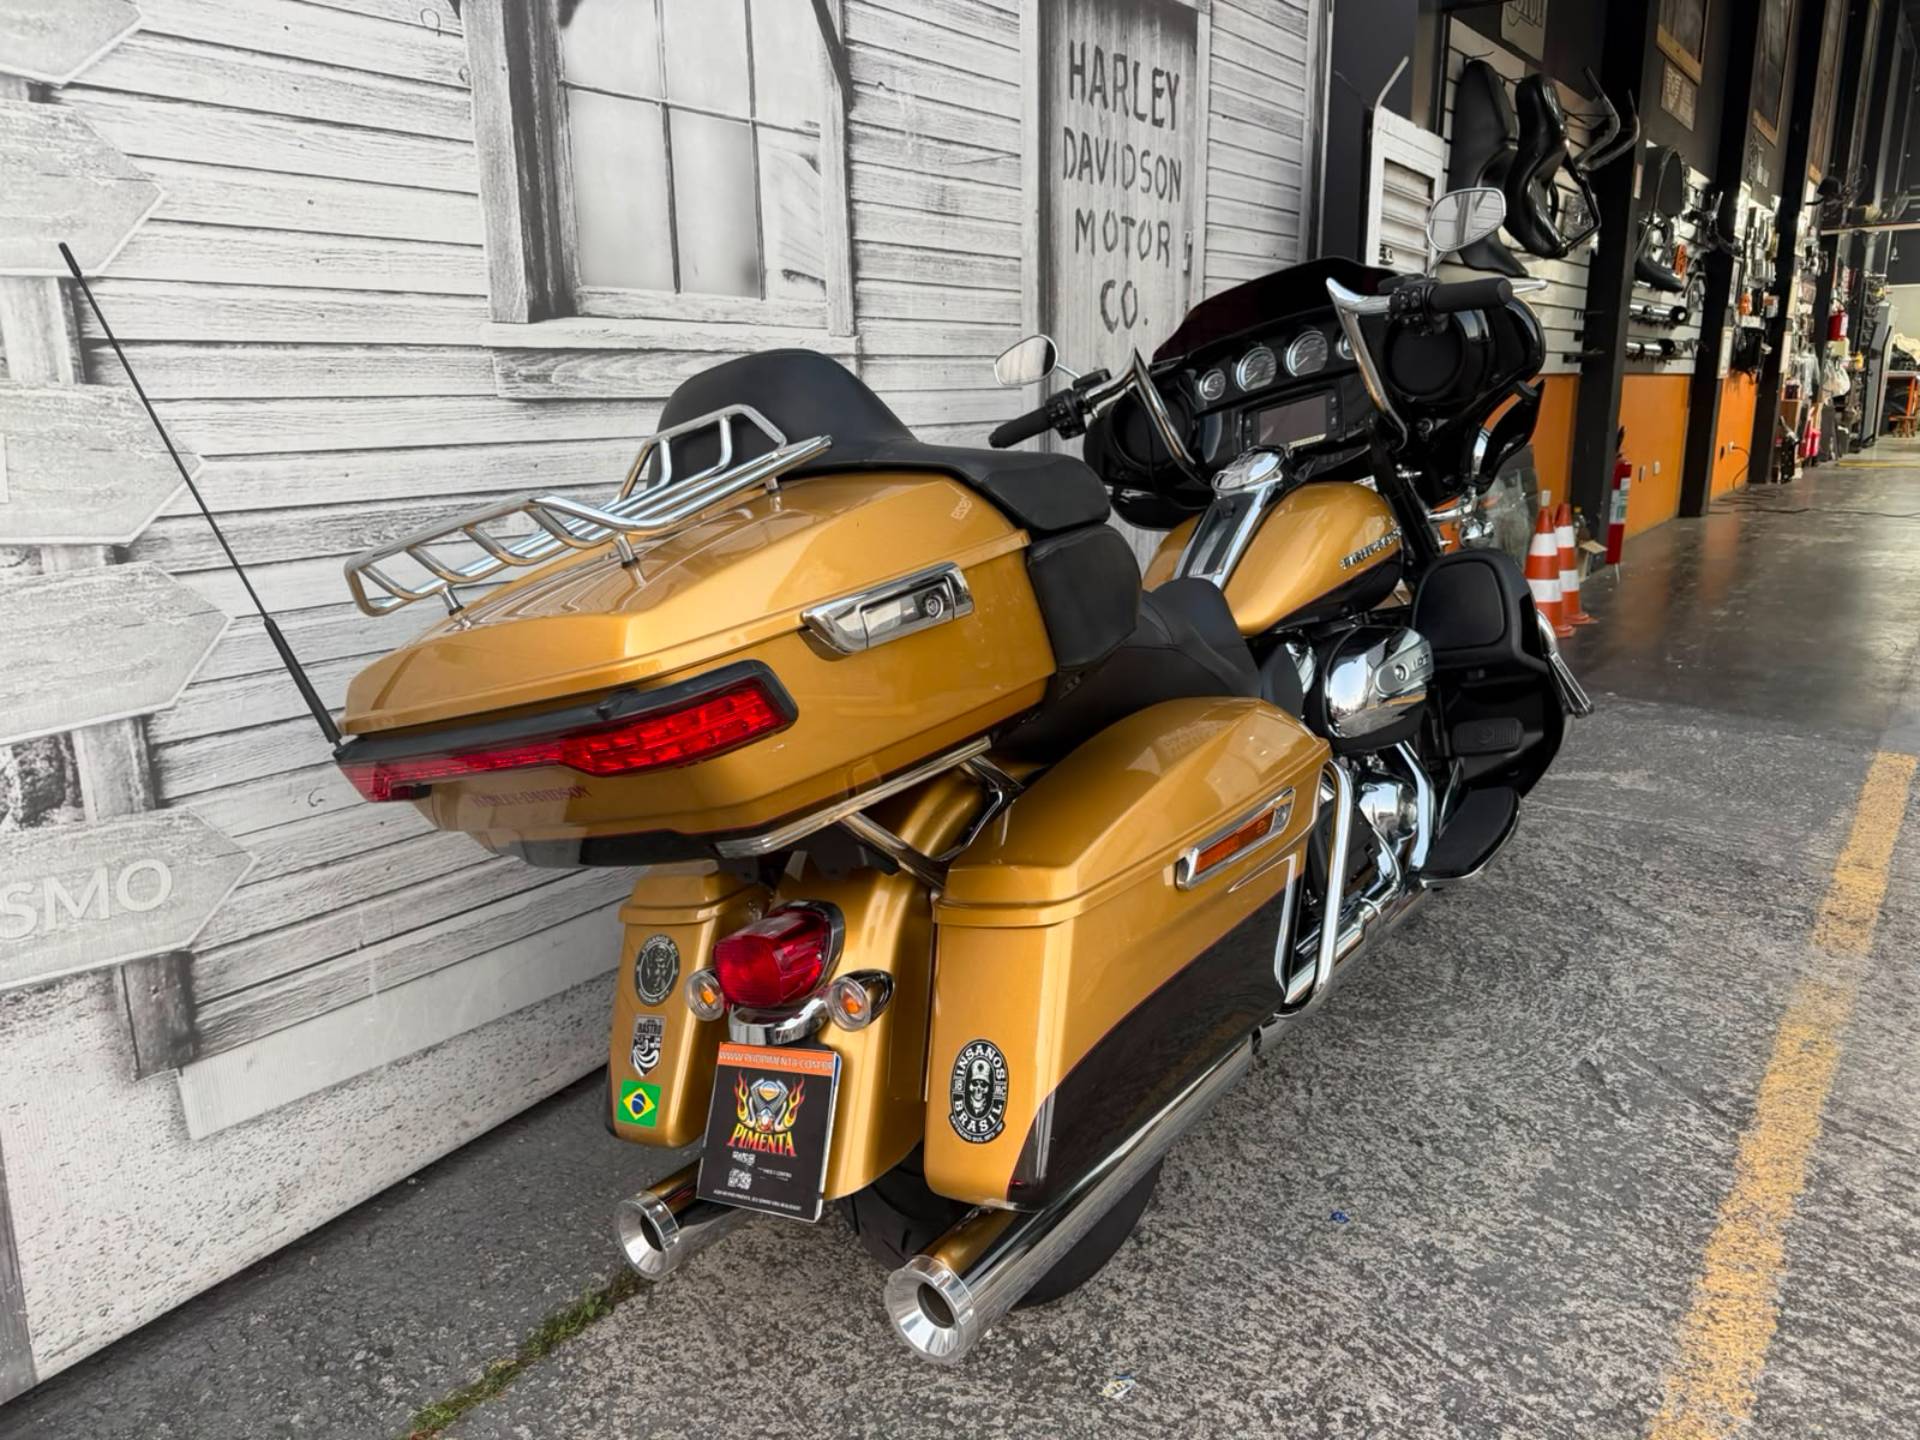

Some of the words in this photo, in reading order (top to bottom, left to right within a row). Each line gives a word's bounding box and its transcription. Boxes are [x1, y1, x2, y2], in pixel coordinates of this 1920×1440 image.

[1069, 39, 1180, 131] HARLEY
[1062, 126, 1182, 203] DAVIDSON
[1074, 207, 1171, 268] MOTOR
[1100, 279, 1149, 334] CO.
[0, 858, 173, 940] SMO
[955, 1044, 1006, 1080] INSANOS
[727, 1122, 798, 1158] PIMENTA
[954, 1100, 1003, 1133] BRASIL
